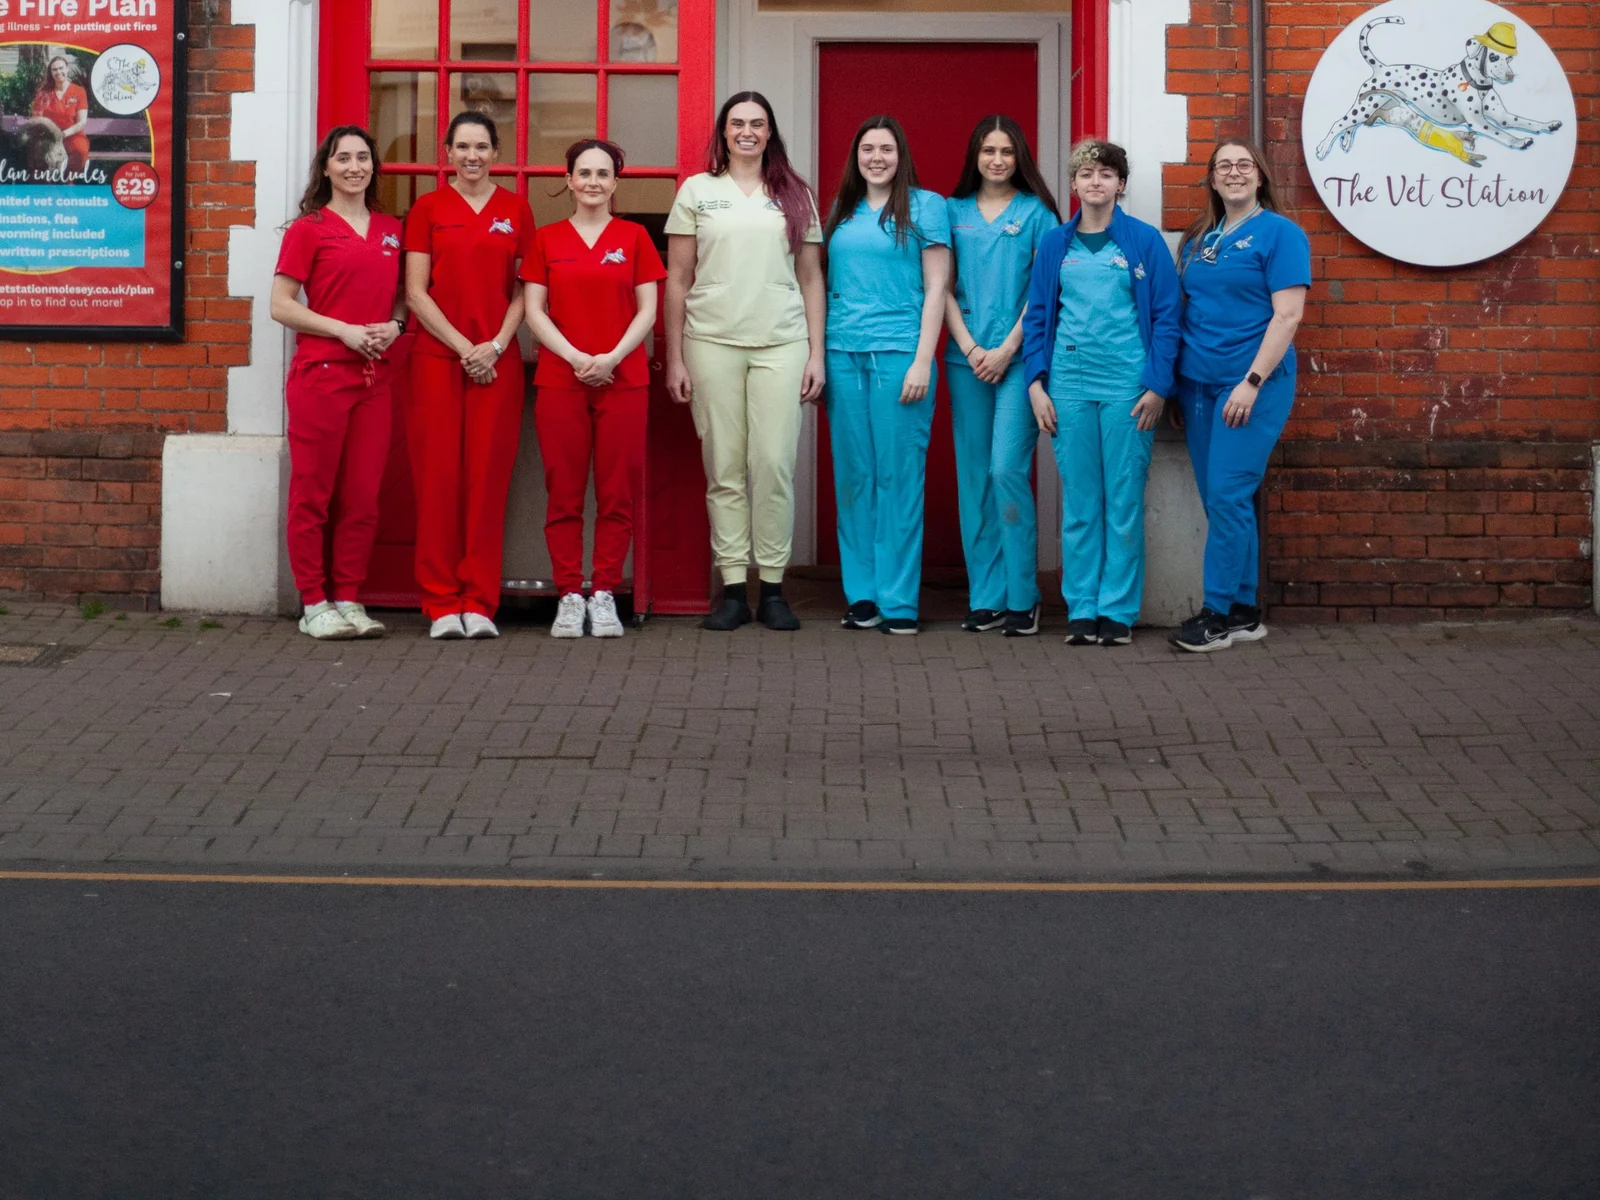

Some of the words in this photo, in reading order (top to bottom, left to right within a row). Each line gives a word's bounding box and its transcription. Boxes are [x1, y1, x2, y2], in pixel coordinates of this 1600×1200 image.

[8, 22, 40, 31] illness
[54, 23, 71, 31] not
[74, 22, 111, 34] putting
[113, 23, 131, 31] out
[133, 22, 157, 31] fires
[34, 158, 108, 184] includes
[115, 178, 155, 195] £29
[1323, 172, 1378, 208] The
[1386, 173, 1434, 208] Vet
[1440, 173, 1550, 208] Station
[33, 197, 53, 206] vet
[56, 196, 109, 206] consults
[54, 213, 78, 224] flea
[52, 228, 105, 239] included
[48, 246, 130, 259] prescriptions
[17, 297, 27, 307] in
[30, 298, 42, 307] to
[45, 297, 66, 307] find
[70, 298, 88, 307] out
[92, 298, 123, 307] more!
